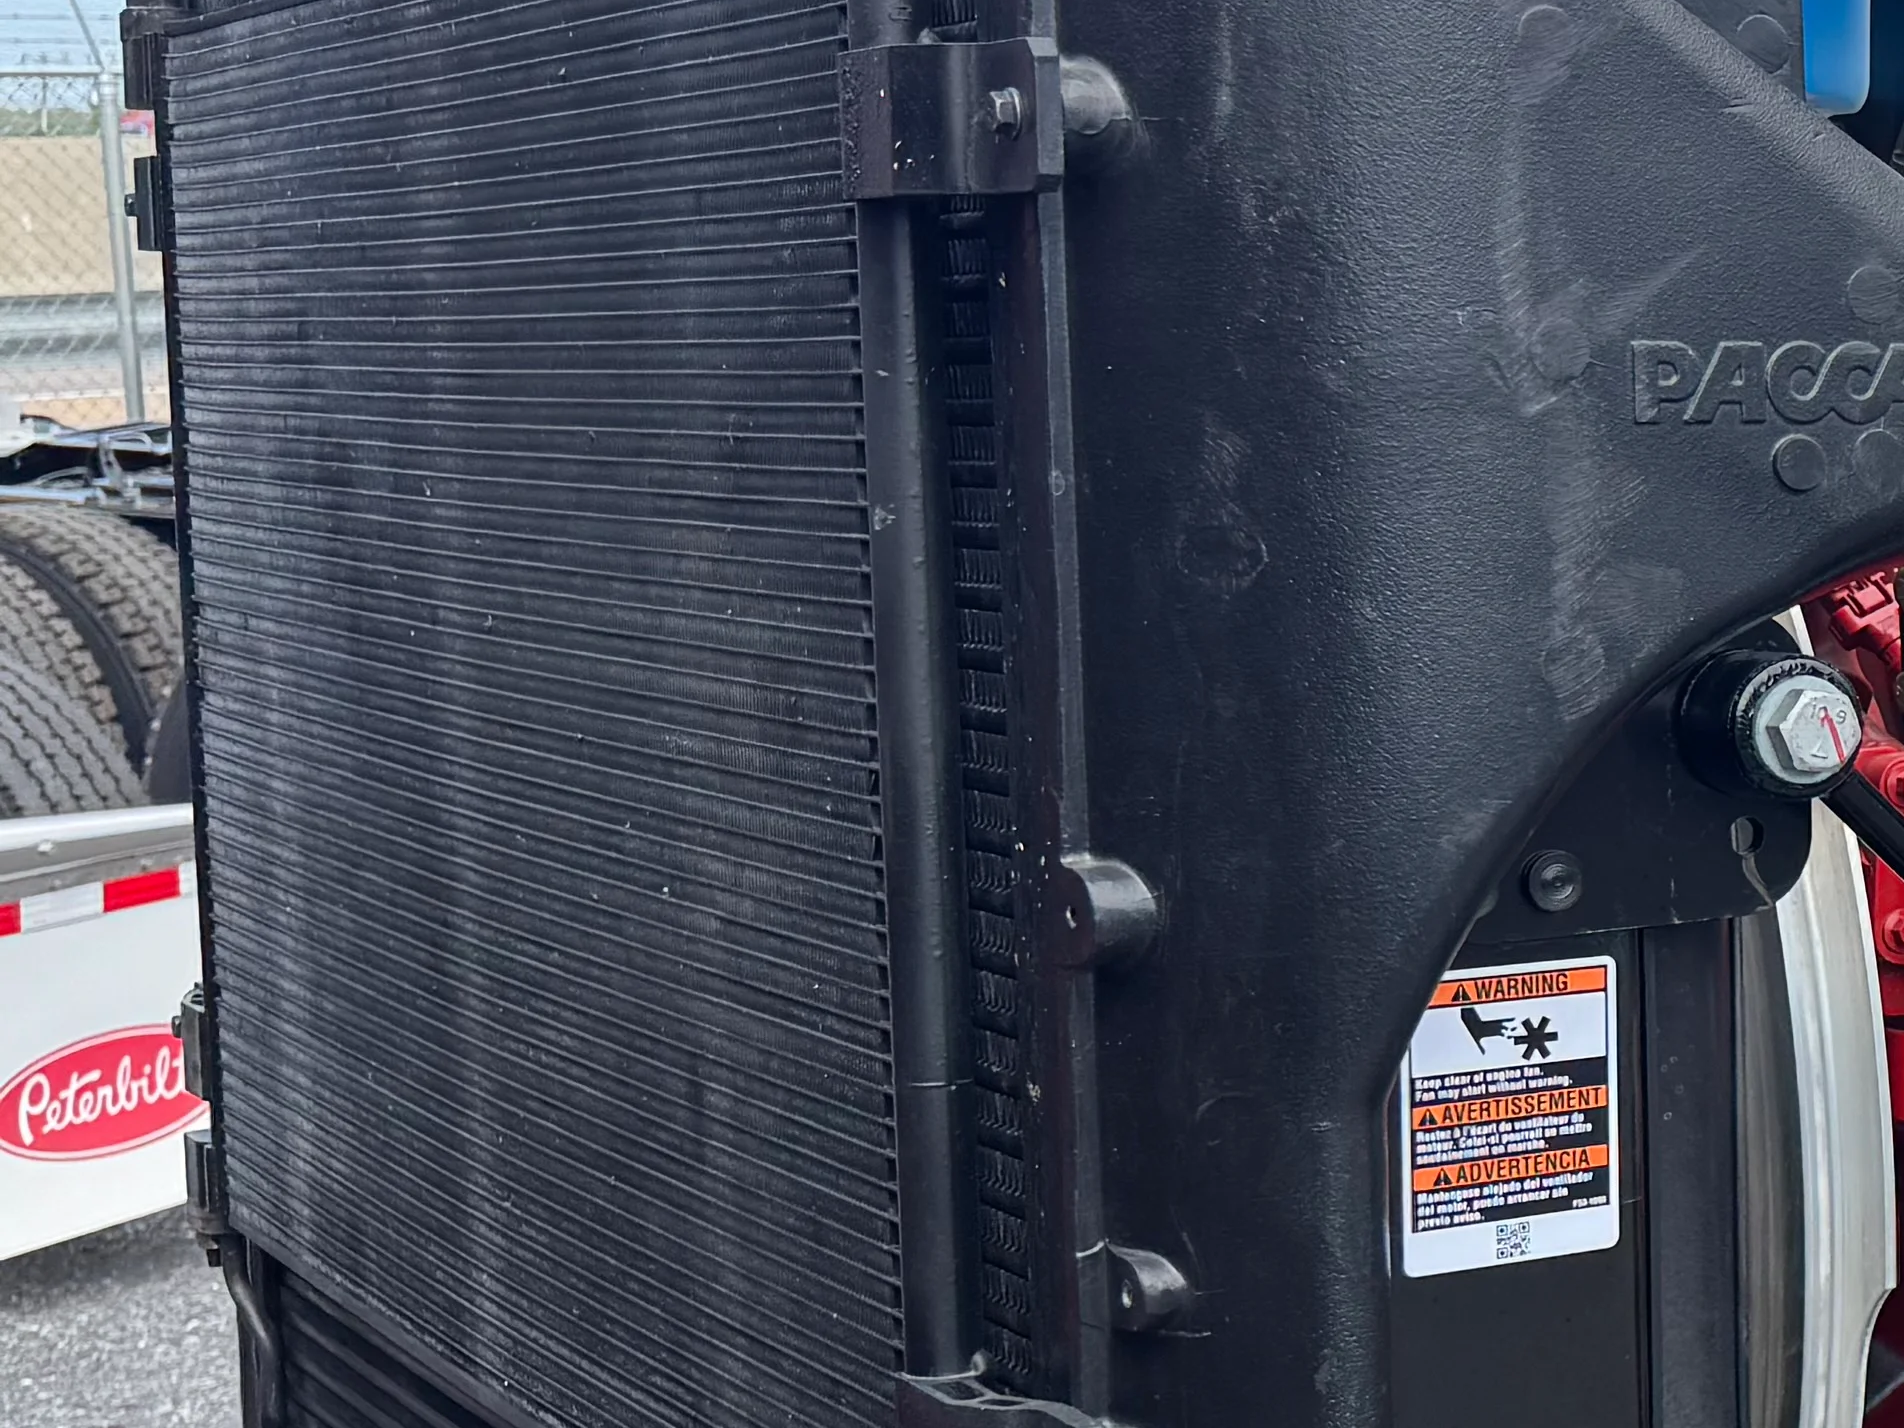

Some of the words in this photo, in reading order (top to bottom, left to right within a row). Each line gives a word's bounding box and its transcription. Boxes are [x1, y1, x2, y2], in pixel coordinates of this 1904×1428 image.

[1474, 972, 1569, 1000] WARNING
[1415, 1078, 1442, 1091] Keep
[1444, 1073, 1471, 1086] clear
[1473, 1072, 1485, 1083] of
[1486, 1068, 1521, 1082] engine
[1523, 1066, 1544, 1077] fan.
[1415, 1090, 1436, 1102] Fan
[1437, 1086, 1461, 1100] may
[1462, 1082, 1486, 1096] start
[1488, 1078, 1527, 1093] without
[1528, 1074, 1573, 1089] warning.
[18, 1045, 185, 1147] Peterbilt
[1442, 1087, 1602, 1123] AVERTISSEMENT
[1456, 1149, 1591, 1184] ADVERTENCIA
